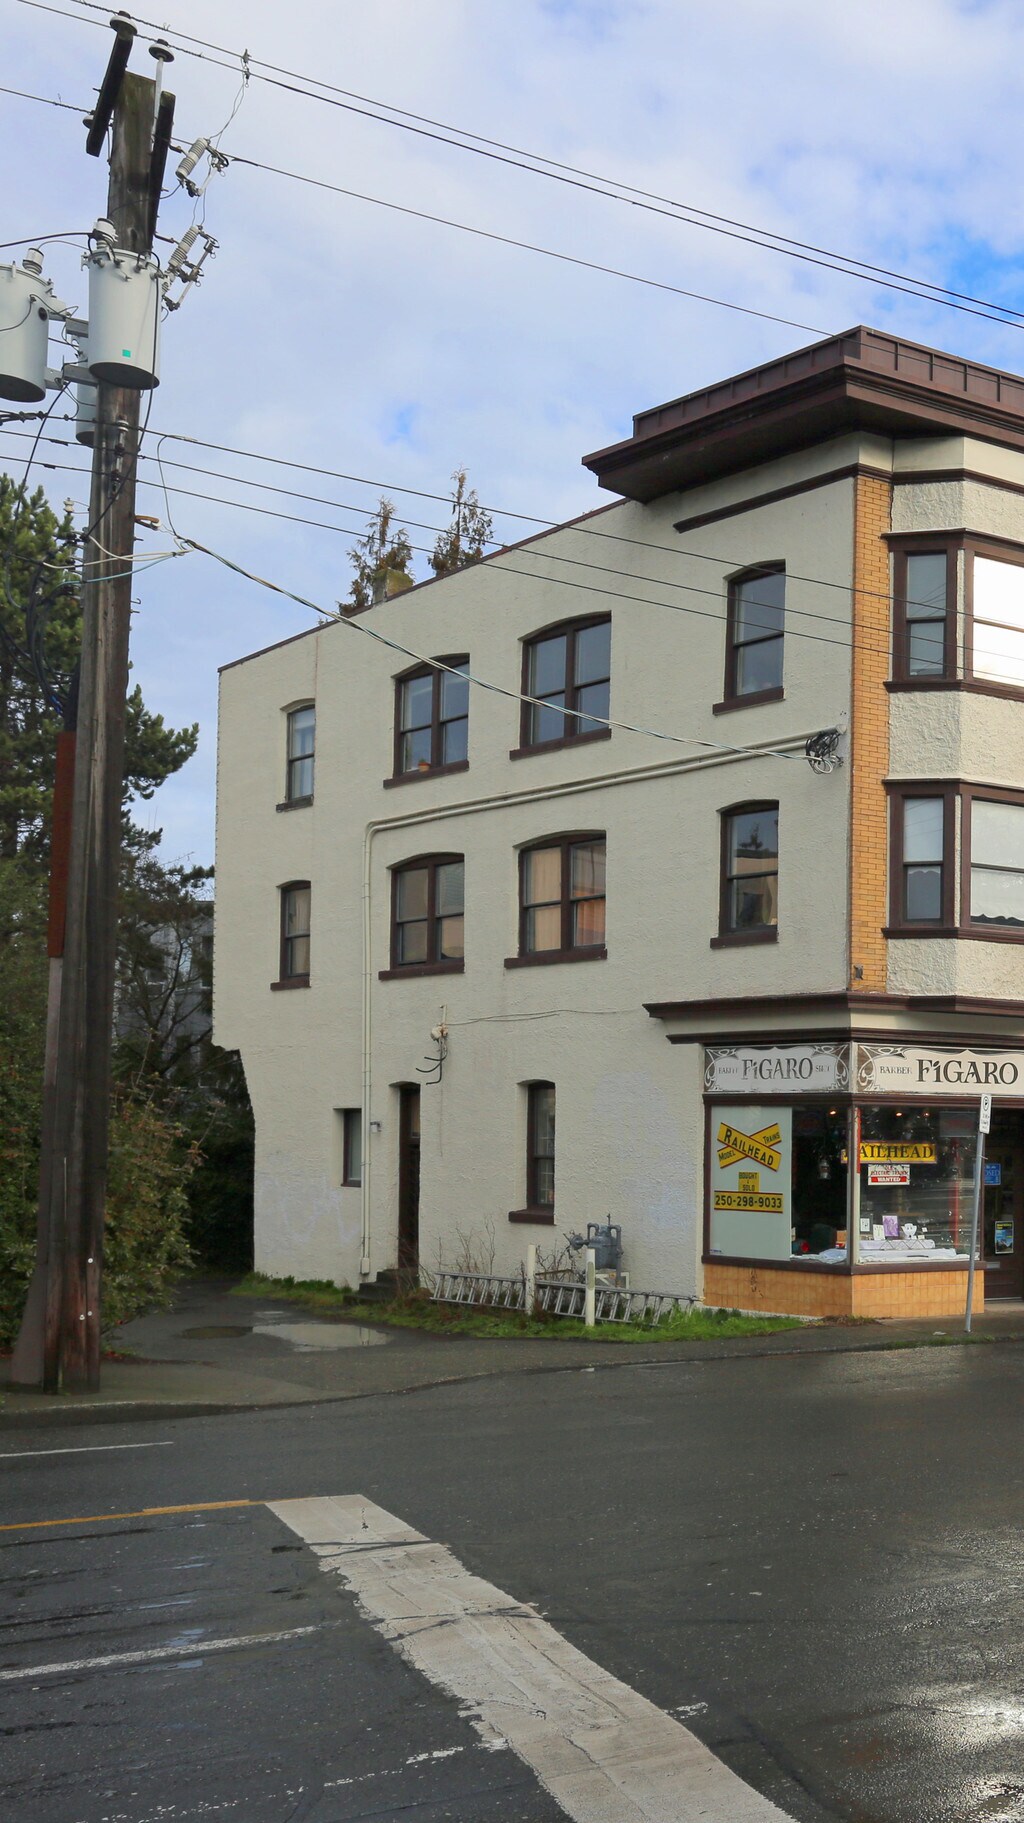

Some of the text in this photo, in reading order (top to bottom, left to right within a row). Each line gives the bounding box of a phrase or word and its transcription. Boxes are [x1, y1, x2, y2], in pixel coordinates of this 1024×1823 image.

[879, 1065, 913, 1075] BARBER
[718, 1132, 780, 1162] MODEL TRAINS
[724, 1128, 774, 1166] RAILHEAD
[846, 1144, 934, 1158] AILHEAD
[742, 1184, 755, 1192] SOLD
[715, 1195, 782, 1209] 250-298-9033
